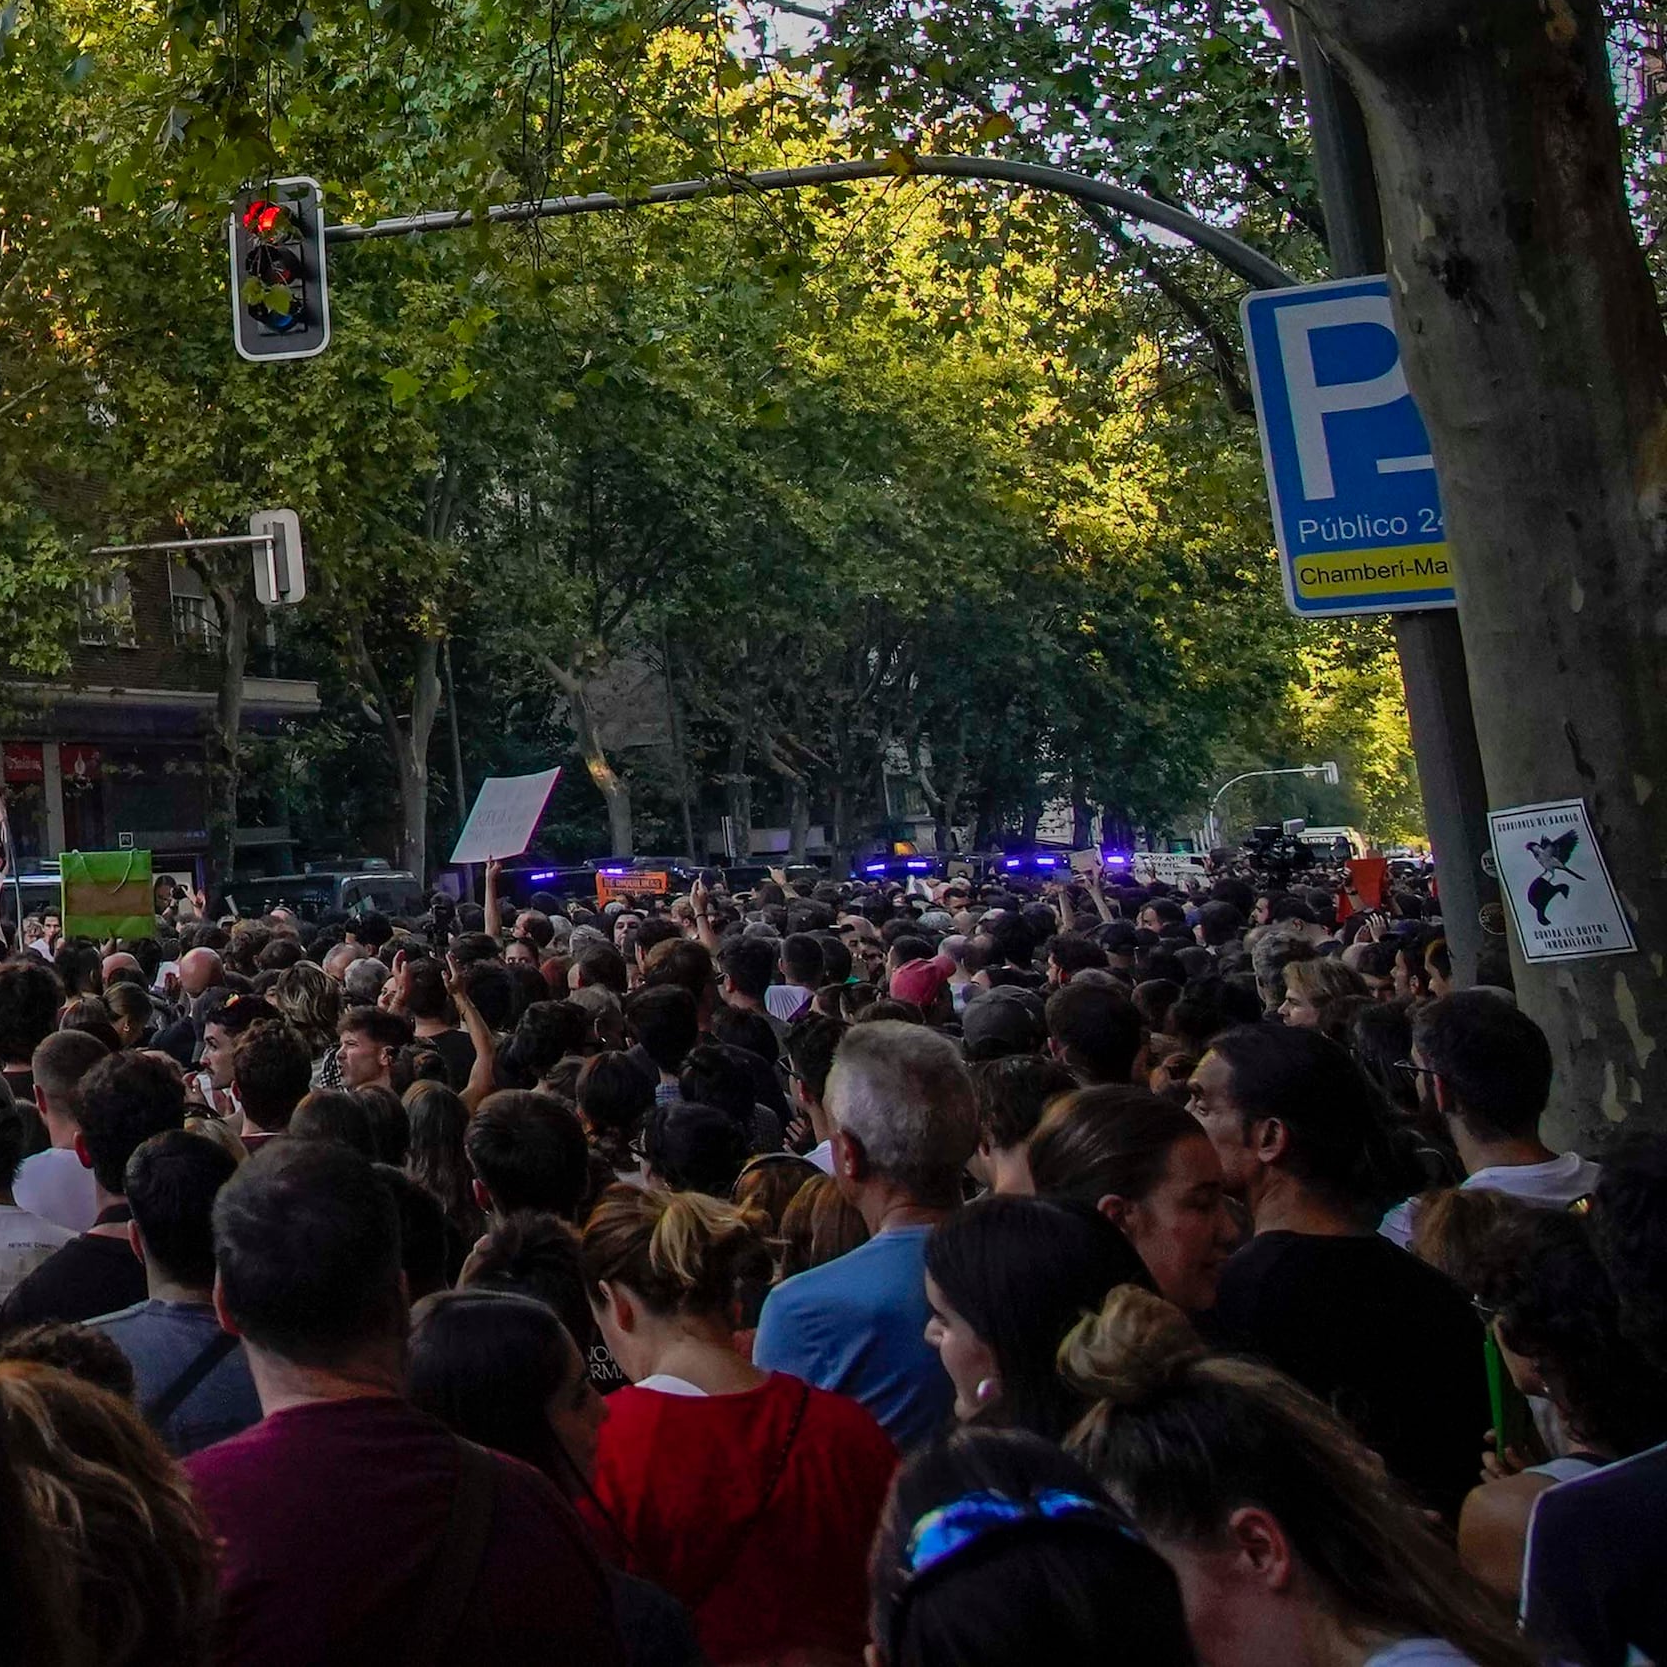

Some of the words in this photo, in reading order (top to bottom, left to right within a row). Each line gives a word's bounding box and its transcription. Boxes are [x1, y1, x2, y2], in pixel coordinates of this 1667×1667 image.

[1274, 295, 1410, 501] P
[1298, 513, 1408, 543] Público
[1300, 558, 1450, 585] Chamberí-Ma
